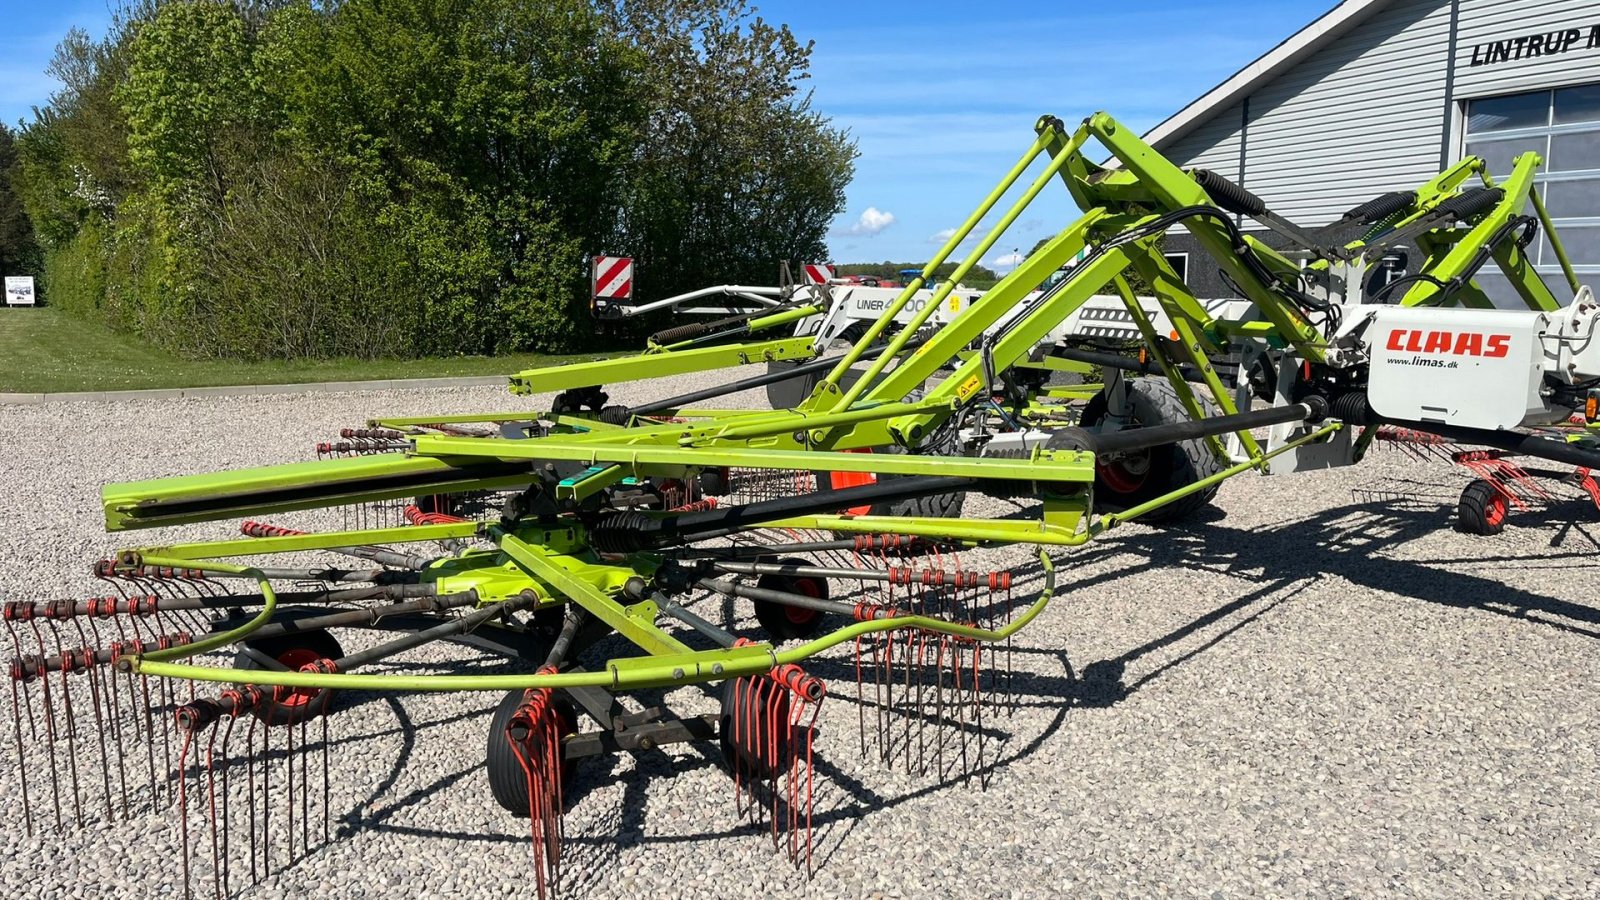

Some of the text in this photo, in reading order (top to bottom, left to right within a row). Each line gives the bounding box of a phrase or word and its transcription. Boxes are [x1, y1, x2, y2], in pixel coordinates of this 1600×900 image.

[1470, 29, 1581, 66] LINTRUP
[857, 298, 926, 313] LINER 400
[1386, 329, 1511, 358] CLAAS
[1387, 356, 1458, 369] www.limas.dk
